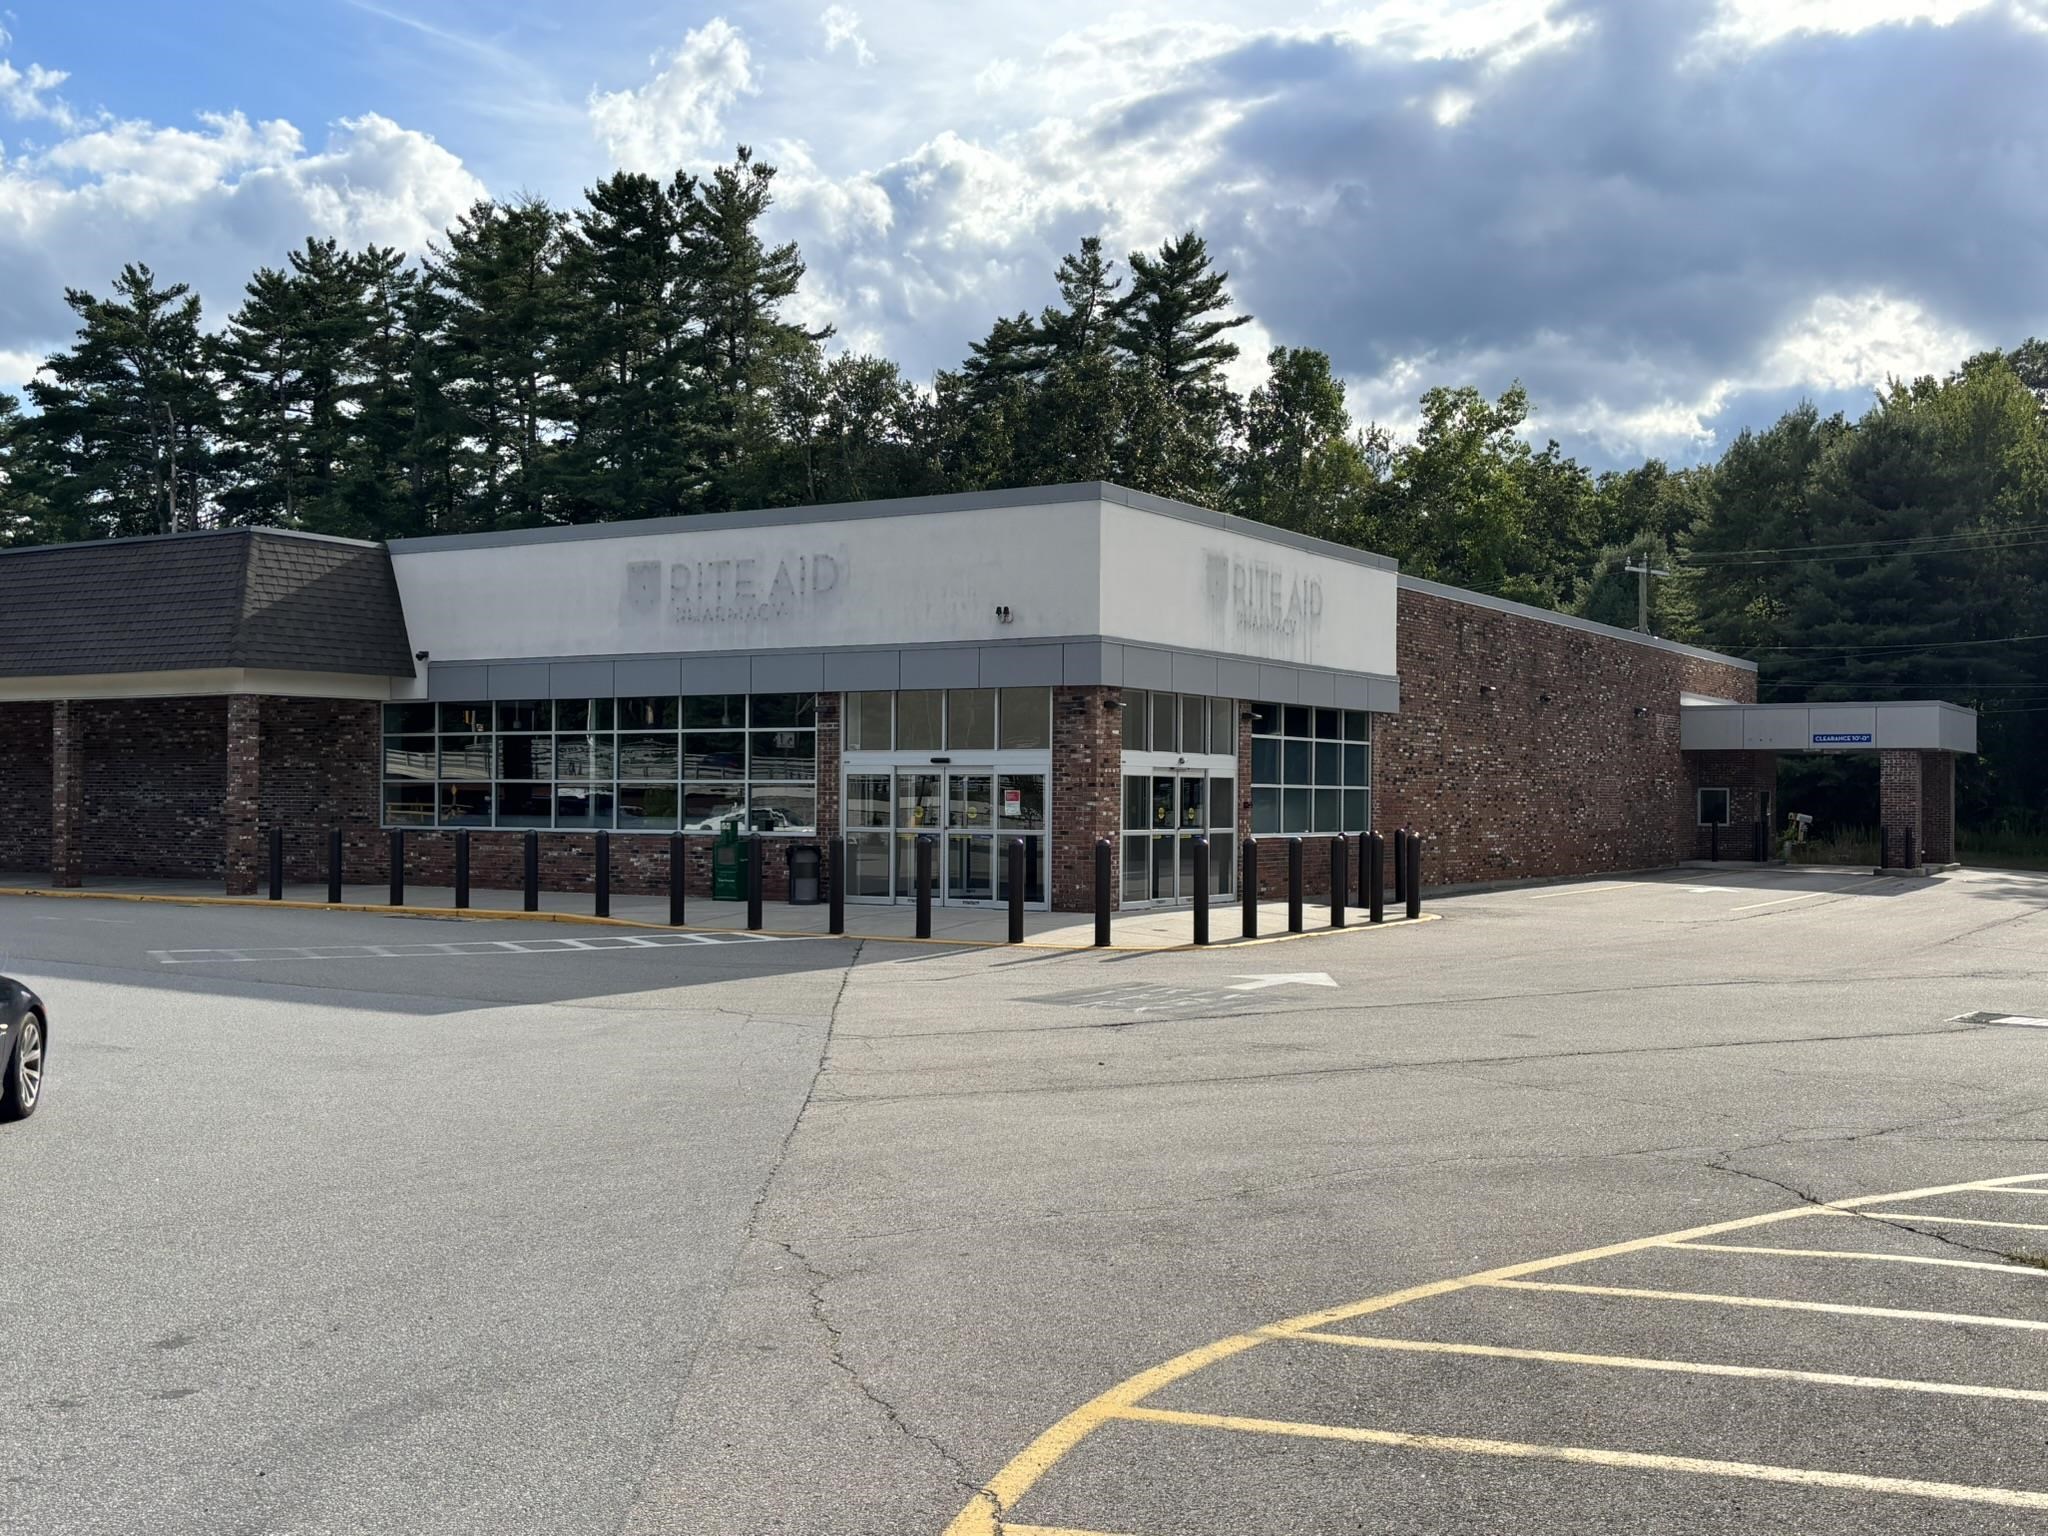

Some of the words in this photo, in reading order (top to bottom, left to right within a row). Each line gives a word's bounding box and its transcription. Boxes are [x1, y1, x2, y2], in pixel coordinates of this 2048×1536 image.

[670, 559, 756, 601] RITE
[768, 553, 840, 598] AID
[1233, 563, 1282, 610] RITE
[1288, 577, 1323, 618] AID
